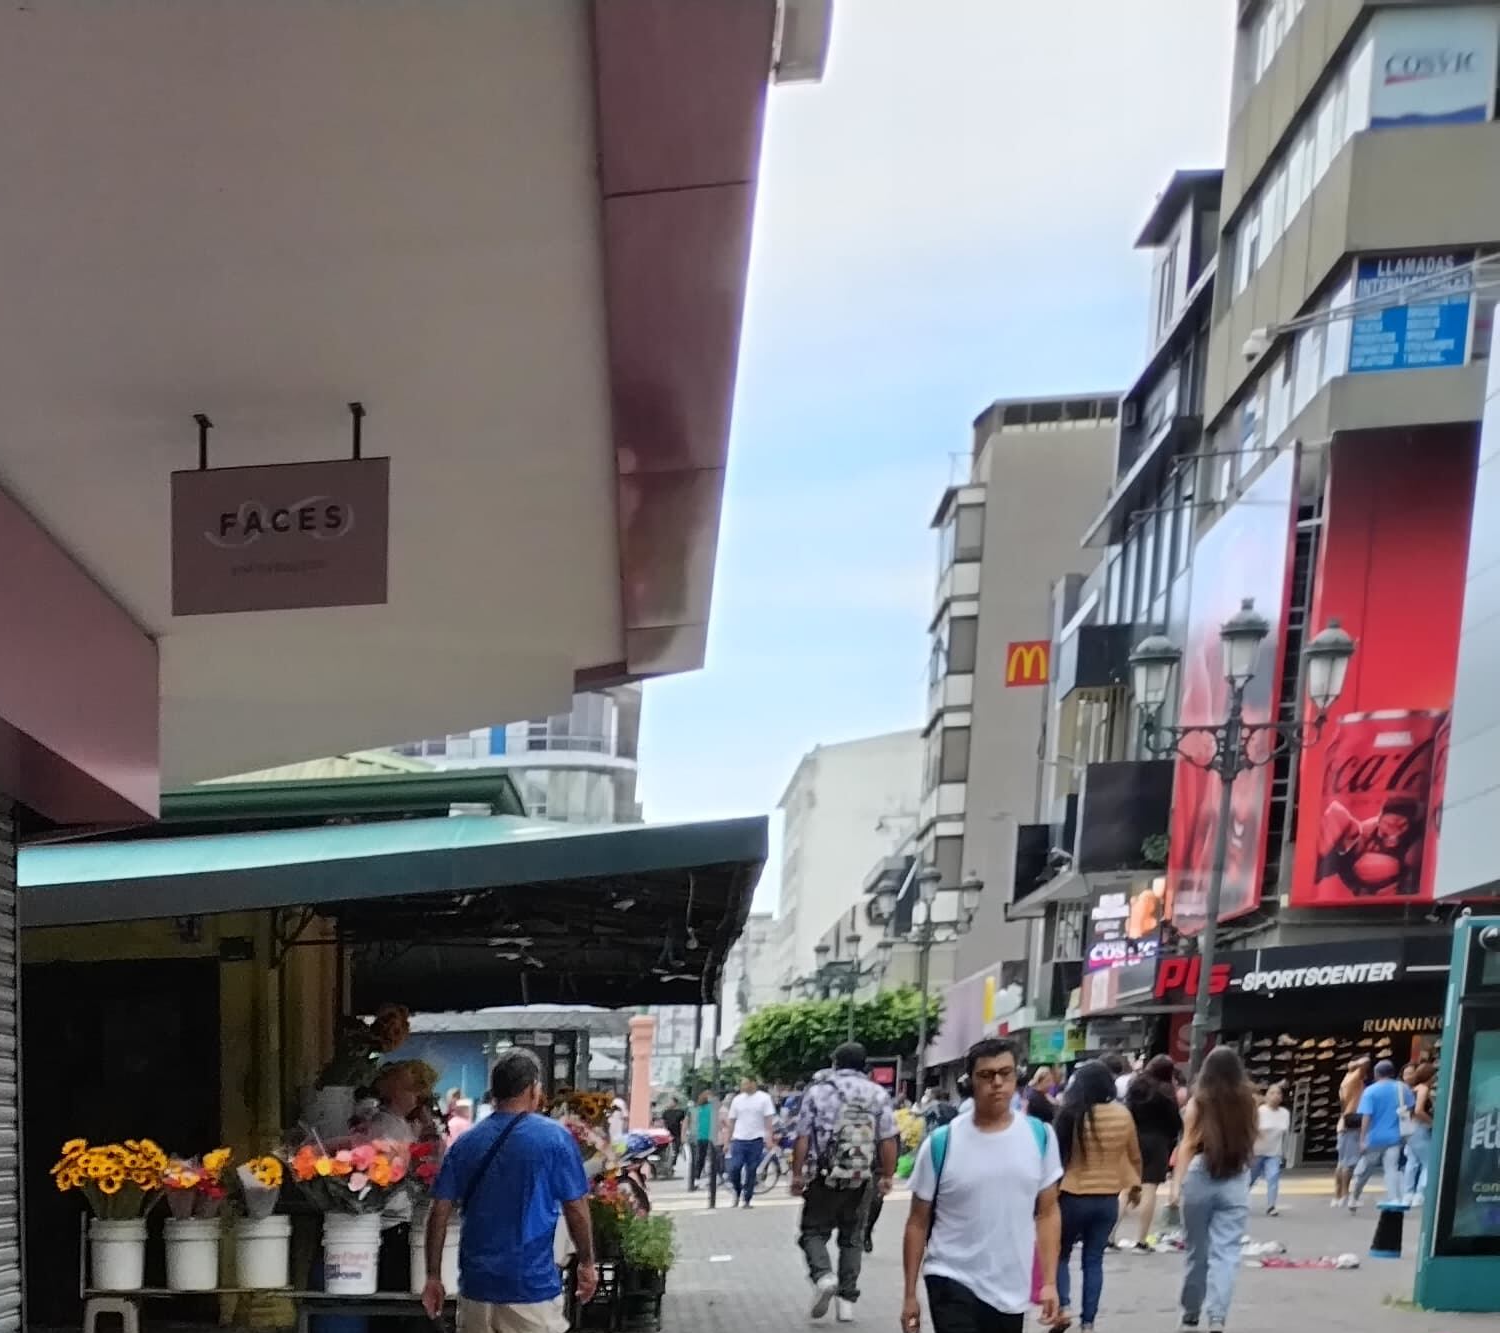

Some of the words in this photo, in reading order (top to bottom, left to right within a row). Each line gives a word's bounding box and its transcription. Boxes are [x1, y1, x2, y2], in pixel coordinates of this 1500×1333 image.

[1377, 256, 1454, 277] LLAMADAS
[219, 504, 344, 537] FACES
[1242, 961, 1397, 991] SPORTSCENTER
[1363, 1016, 1443, 1033] RUNNIN
